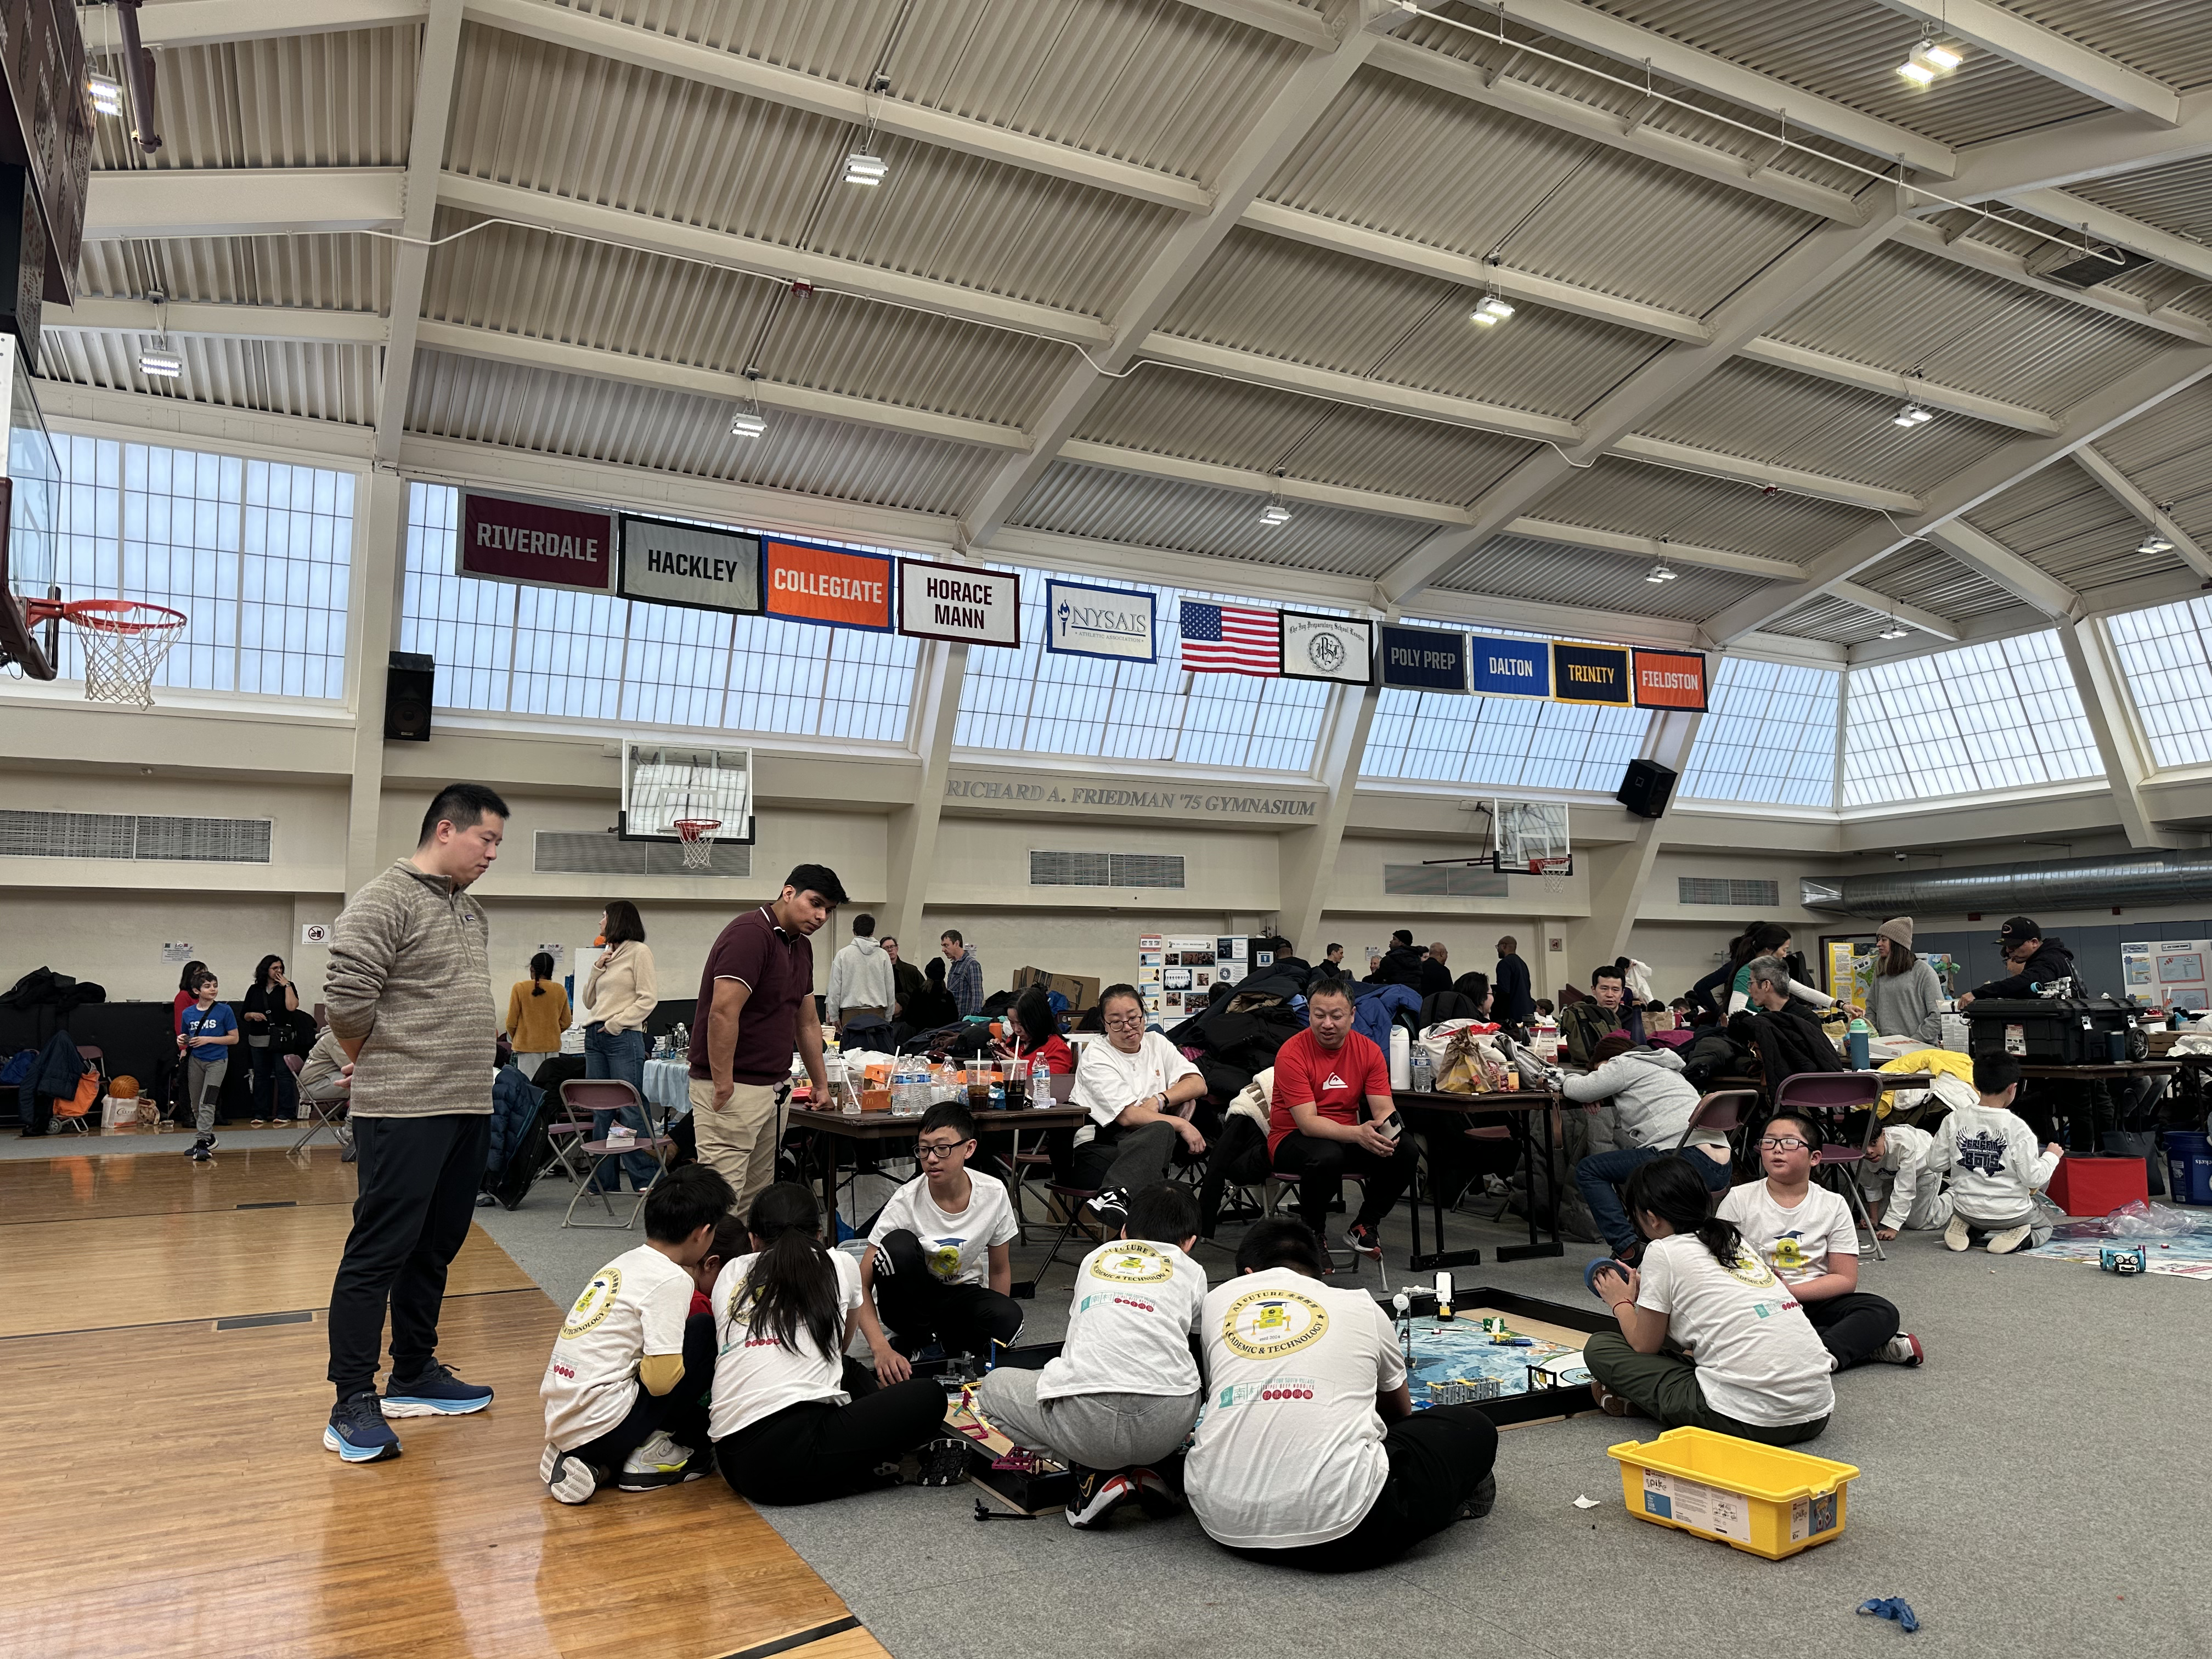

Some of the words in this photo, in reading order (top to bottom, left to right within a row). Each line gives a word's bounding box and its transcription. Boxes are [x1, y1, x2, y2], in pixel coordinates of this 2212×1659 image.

[39, 60, 49, 108] PLAYER
[81, 63, 98, 133] GUEST
[477, 522, 598, 563] RIVERDALE
[647, 549, 738, 583] HACKLEY
[774, 568, 882, 604] COLLEGIATE
[927, 577, 992, 606] HORACE
[935, 604, 985, 629] MANN
[1071, 606, 1147, 633] NYSAIS
[1307, 621, 1333, 630] Preparatory
[1334, 623, 1349, 633] School
[1079, 631, 1105, 639] ATHLETIC
[1106, 635, 1141, 643] ASSOCIATION
[1391, 647, 1421, 667] POLY
[1424, 650, 1456, 670] PREP
[1489, 656, 1533, 677] DALTON
[1567, 664, 1615, 684] TRINITY
[1641, 670, 1699, 690] FIELDSTON
[946, 780, 1043, 802] RICHARD
[1047, 786, 1066, 803] A.
[1070, 787, 1177, 809] FRIEDMAN
[1180, 794, 1203, 810] '75
[1205, 795, 1317, 816] GYMNASIUM
[1233, 1302, 1243, 1312] AI
[1242, 1291, 1285, 1303] FUTURE
[566, 1311, 605, 1335] TECHNOLOGY
[1267, 1321, 1323, 1354] TECHNOLOGY
[337, 1420, 354, 1440] HOKA
